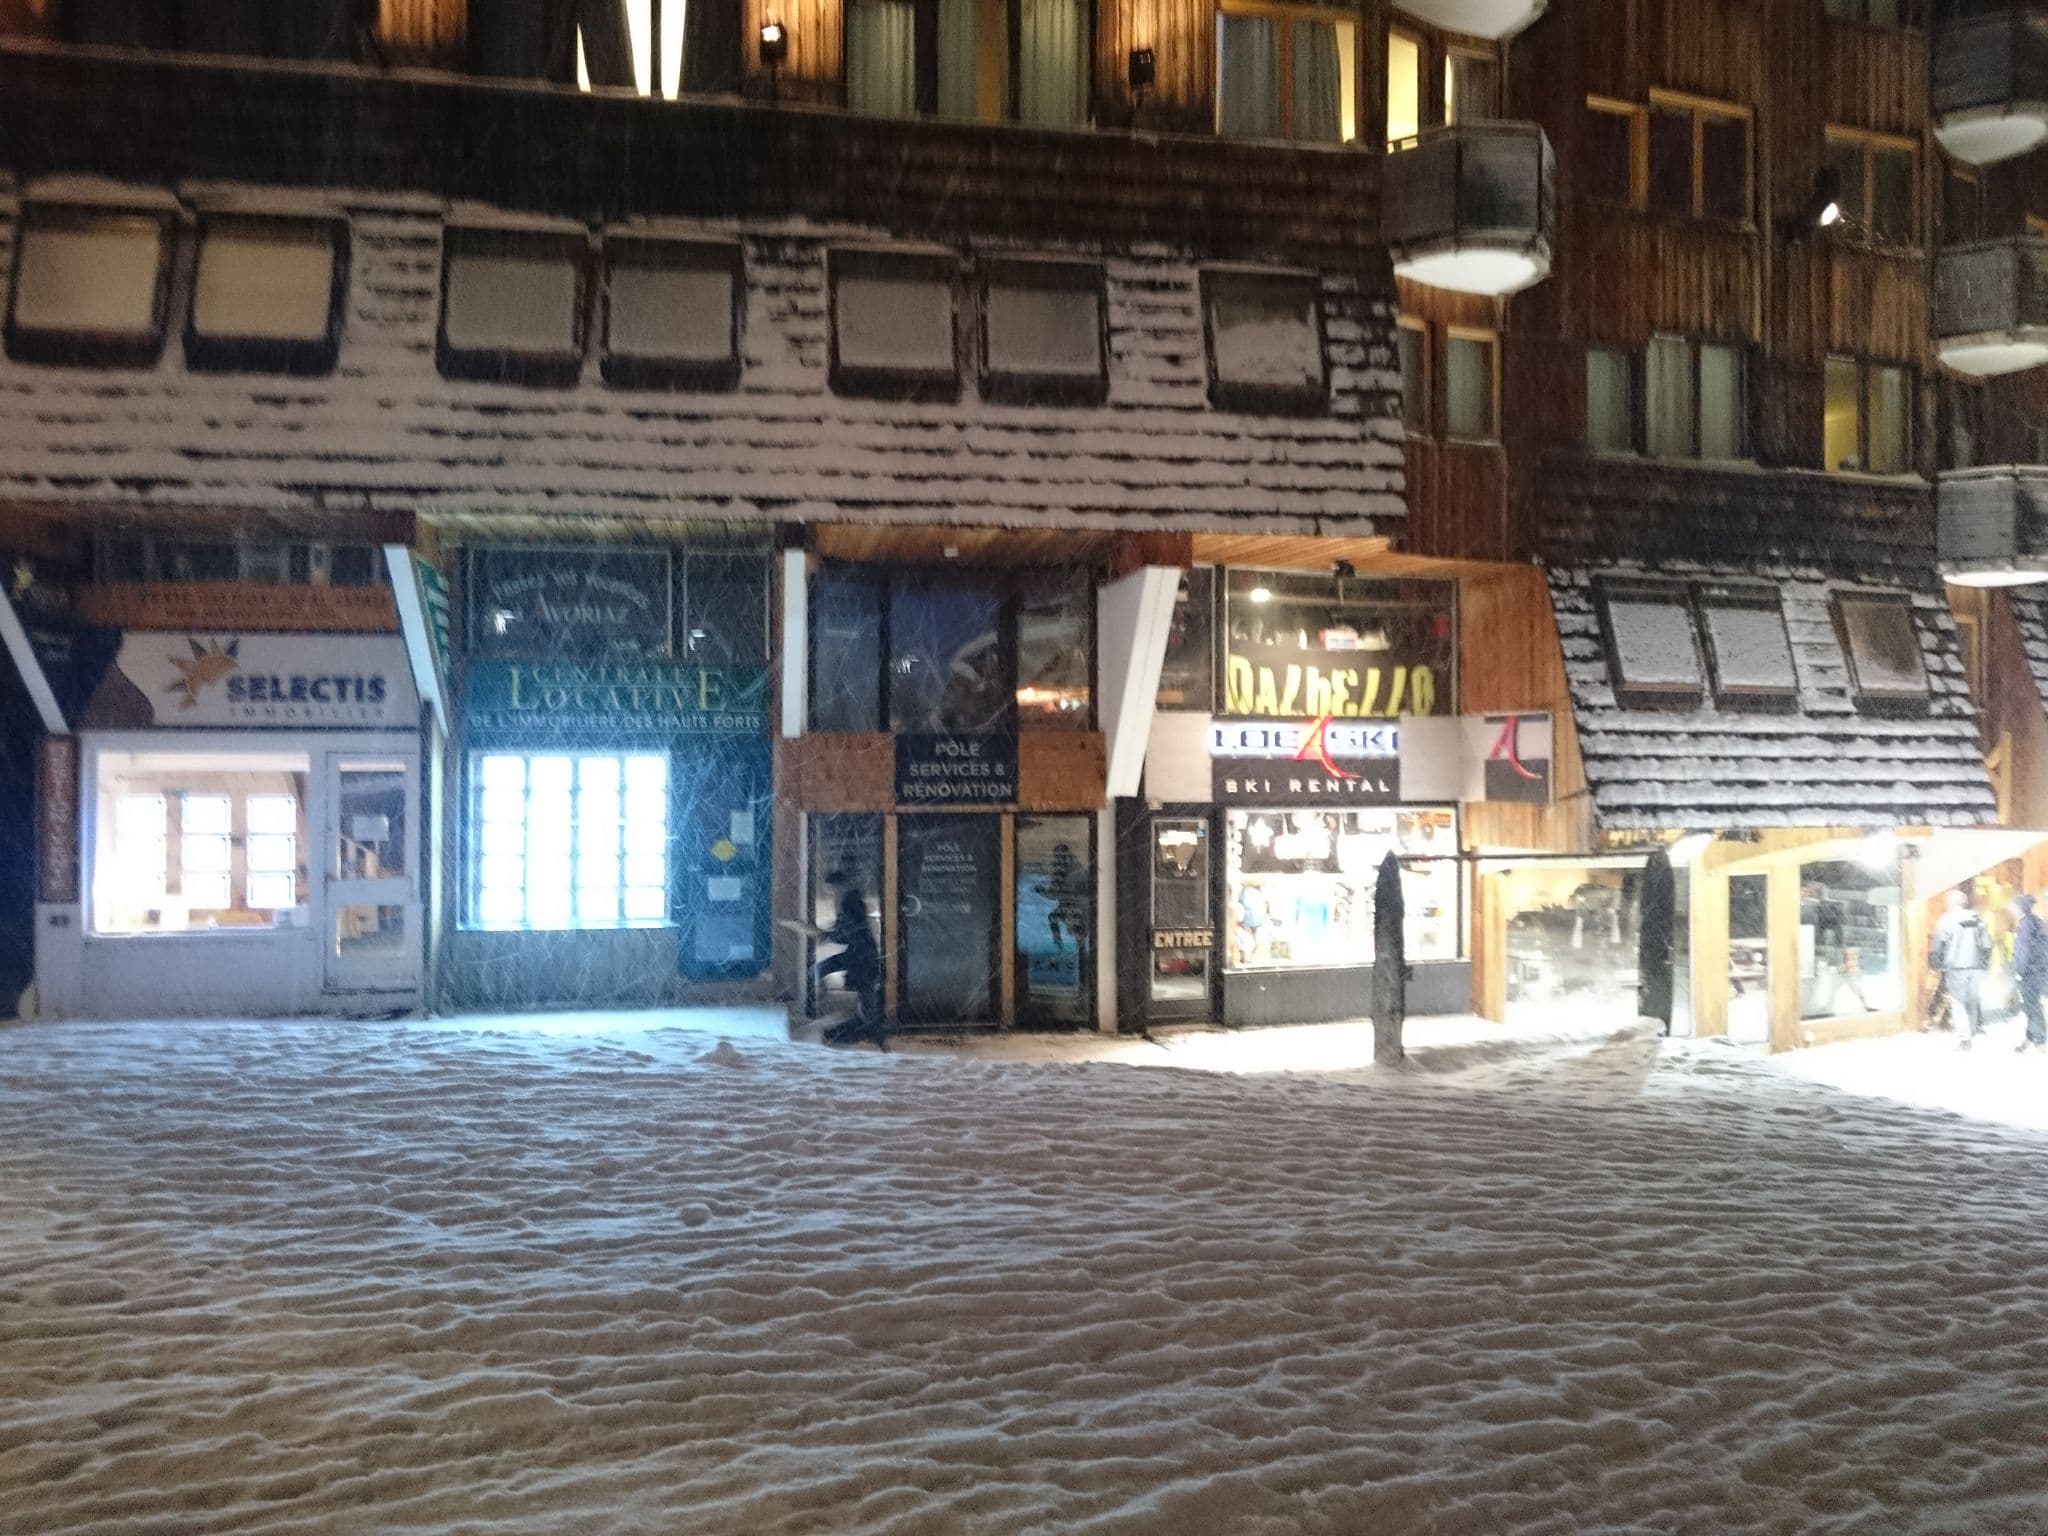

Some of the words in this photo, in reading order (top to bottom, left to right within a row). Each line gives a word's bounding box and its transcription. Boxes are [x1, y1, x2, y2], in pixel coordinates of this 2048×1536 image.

[228, 675, 386, 703] SELECTIS
[510, 666, 724, 710] LOCATIVE
[910, 763, 990, 777] SERVICES
[994, 763, 1006, 777] &
[1225, 778, 1271, 793] SKI
[1289, 778, 1391, 793] RENTAL
